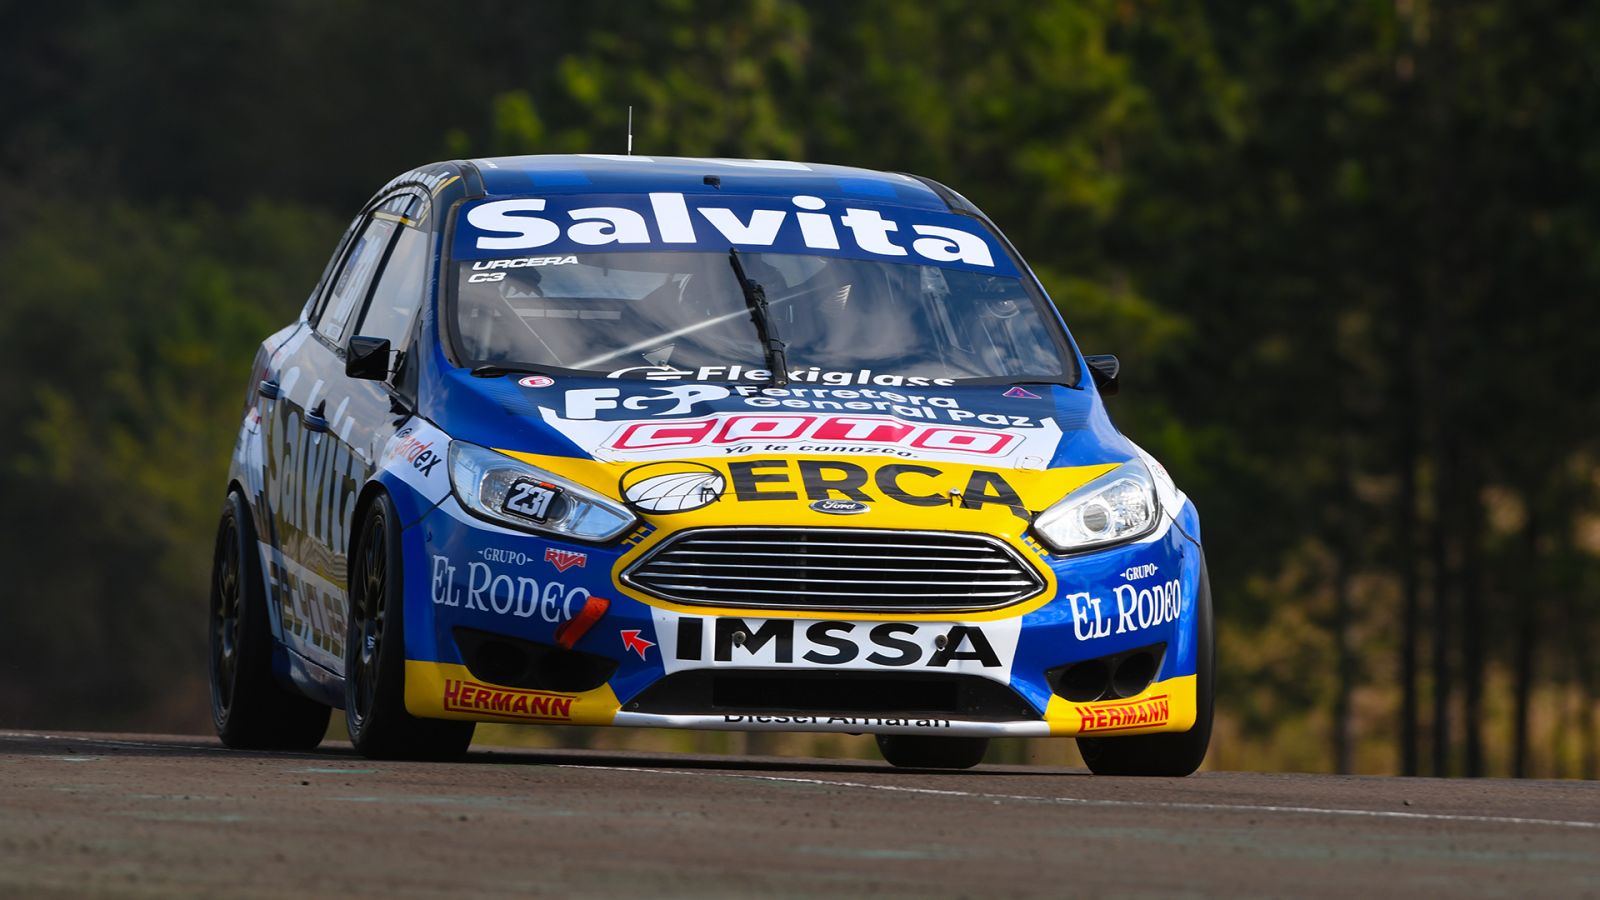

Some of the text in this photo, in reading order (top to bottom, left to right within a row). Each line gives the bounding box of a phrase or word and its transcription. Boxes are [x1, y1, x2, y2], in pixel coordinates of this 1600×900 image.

[467, 192, 995, 267] Salvita
[468, 272, 506, 283] C3
[472, 255, 579, 271] URCERA
[735, 385, 960, 409] Ferretera
[743, 396, 1035, 427] General Paz
[612, 414, 1016, 455] COTO
[724, 445, 753, 454] Yo
[799, 445, 919, 458] conozco.
[507, 482, 555, 518] 231
[728, 458, 1031, 523] ERCA
[822, 500, 856, 509] Ford
[483, 547, 527, 565] GRUPO
[1126, 563, 1155, 581] GRUPO
[432, 555, 460, 607] EL
[1066, 579, 1181, 641] EL RODEO
[676, 616, 1003, 667] IMSSA
[444, 679, 574, 720] HERMANN
[1075, 696, 1169, 732] HERMANN
